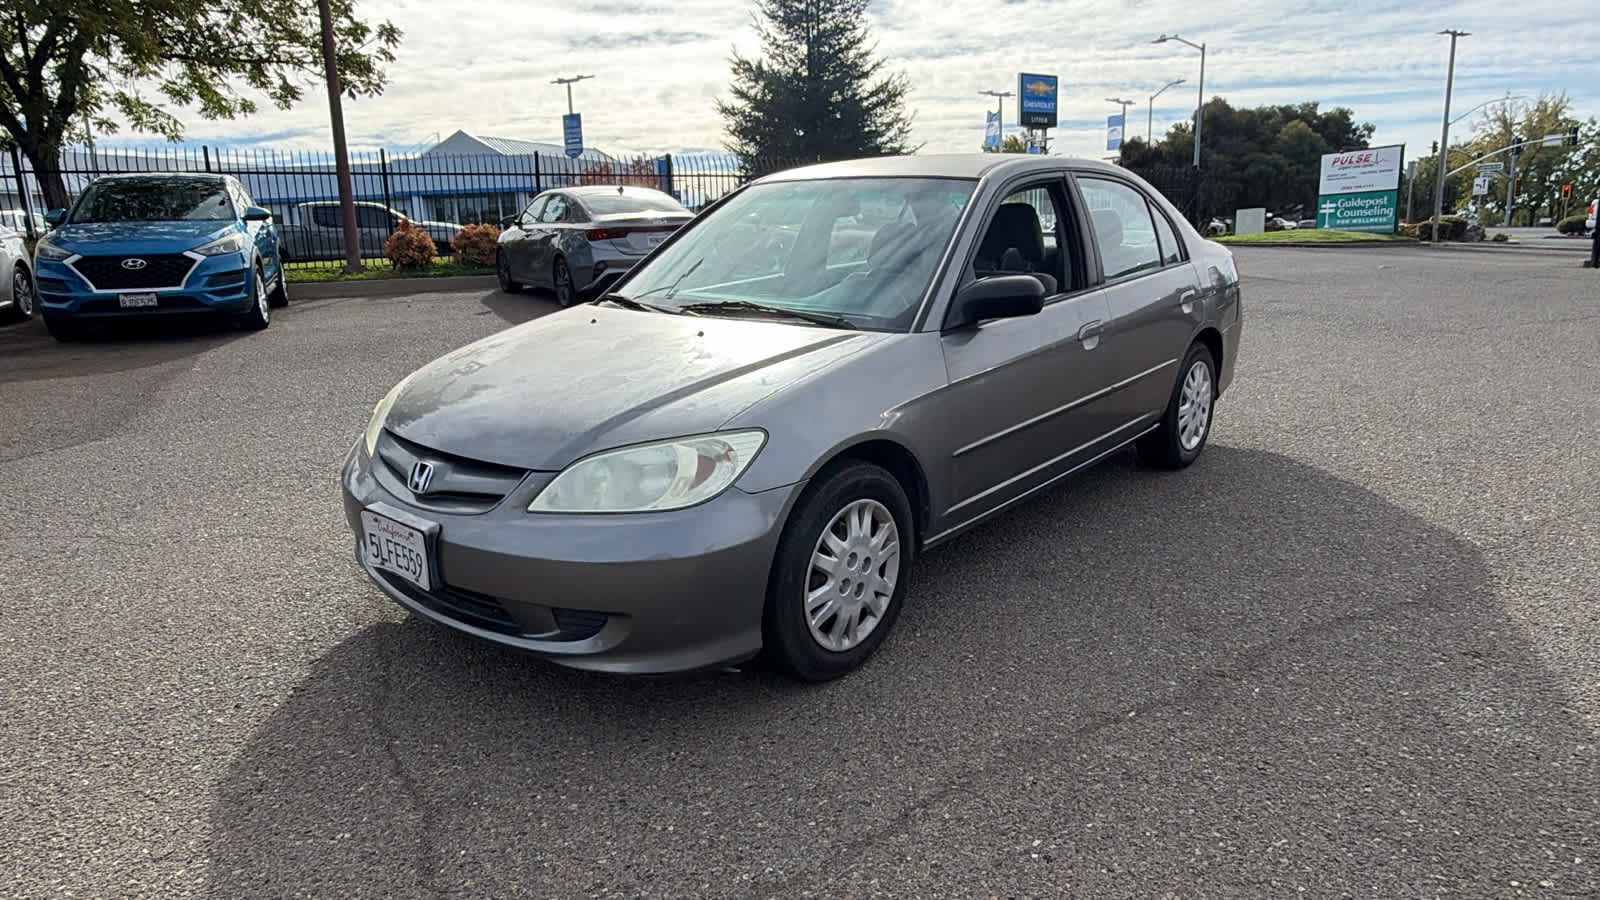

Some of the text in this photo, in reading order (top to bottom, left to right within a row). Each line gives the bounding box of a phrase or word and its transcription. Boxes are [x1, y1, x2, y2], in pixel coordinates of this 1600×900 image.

[1332, 153, 1372, 166] PULSE
[1337, 196, 1388, 208] Guidepost
[1336, 205, 1393, 218] Counseling
[377, 519, 411, 541] California
[369, 532, 423, 579] 5LFE559
